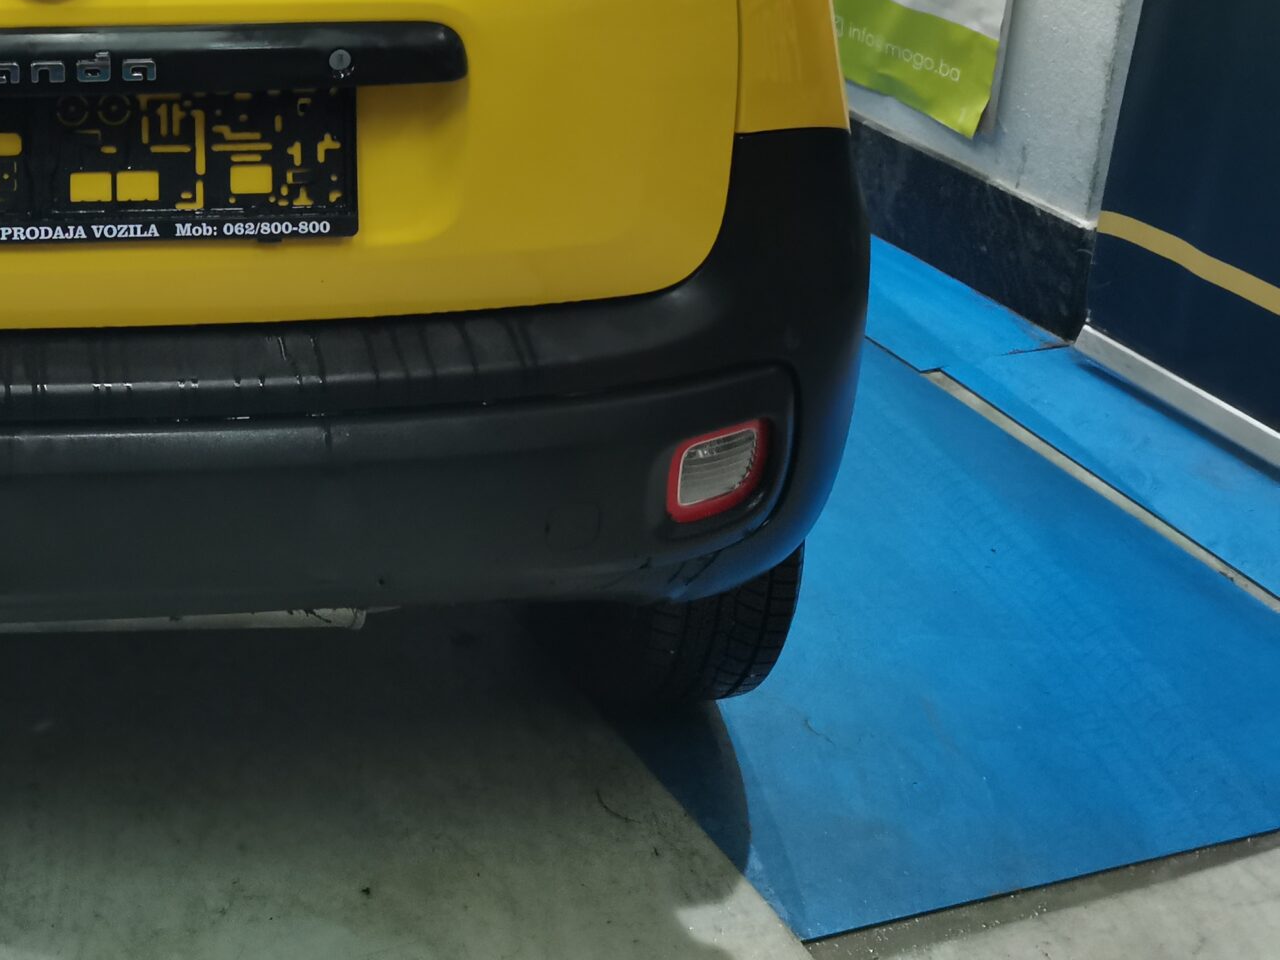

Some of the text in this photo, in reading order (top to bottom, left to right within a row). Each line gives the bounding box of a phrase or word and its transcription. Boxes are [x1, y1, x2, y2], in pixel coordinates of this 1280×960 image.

[0, 225, 87, 241] PRODAJA
[91, 223, 160, 239] VOZILA
[175, 223, 218, 237] Mob:
[223, 220, 331, 236] 062/800-800
